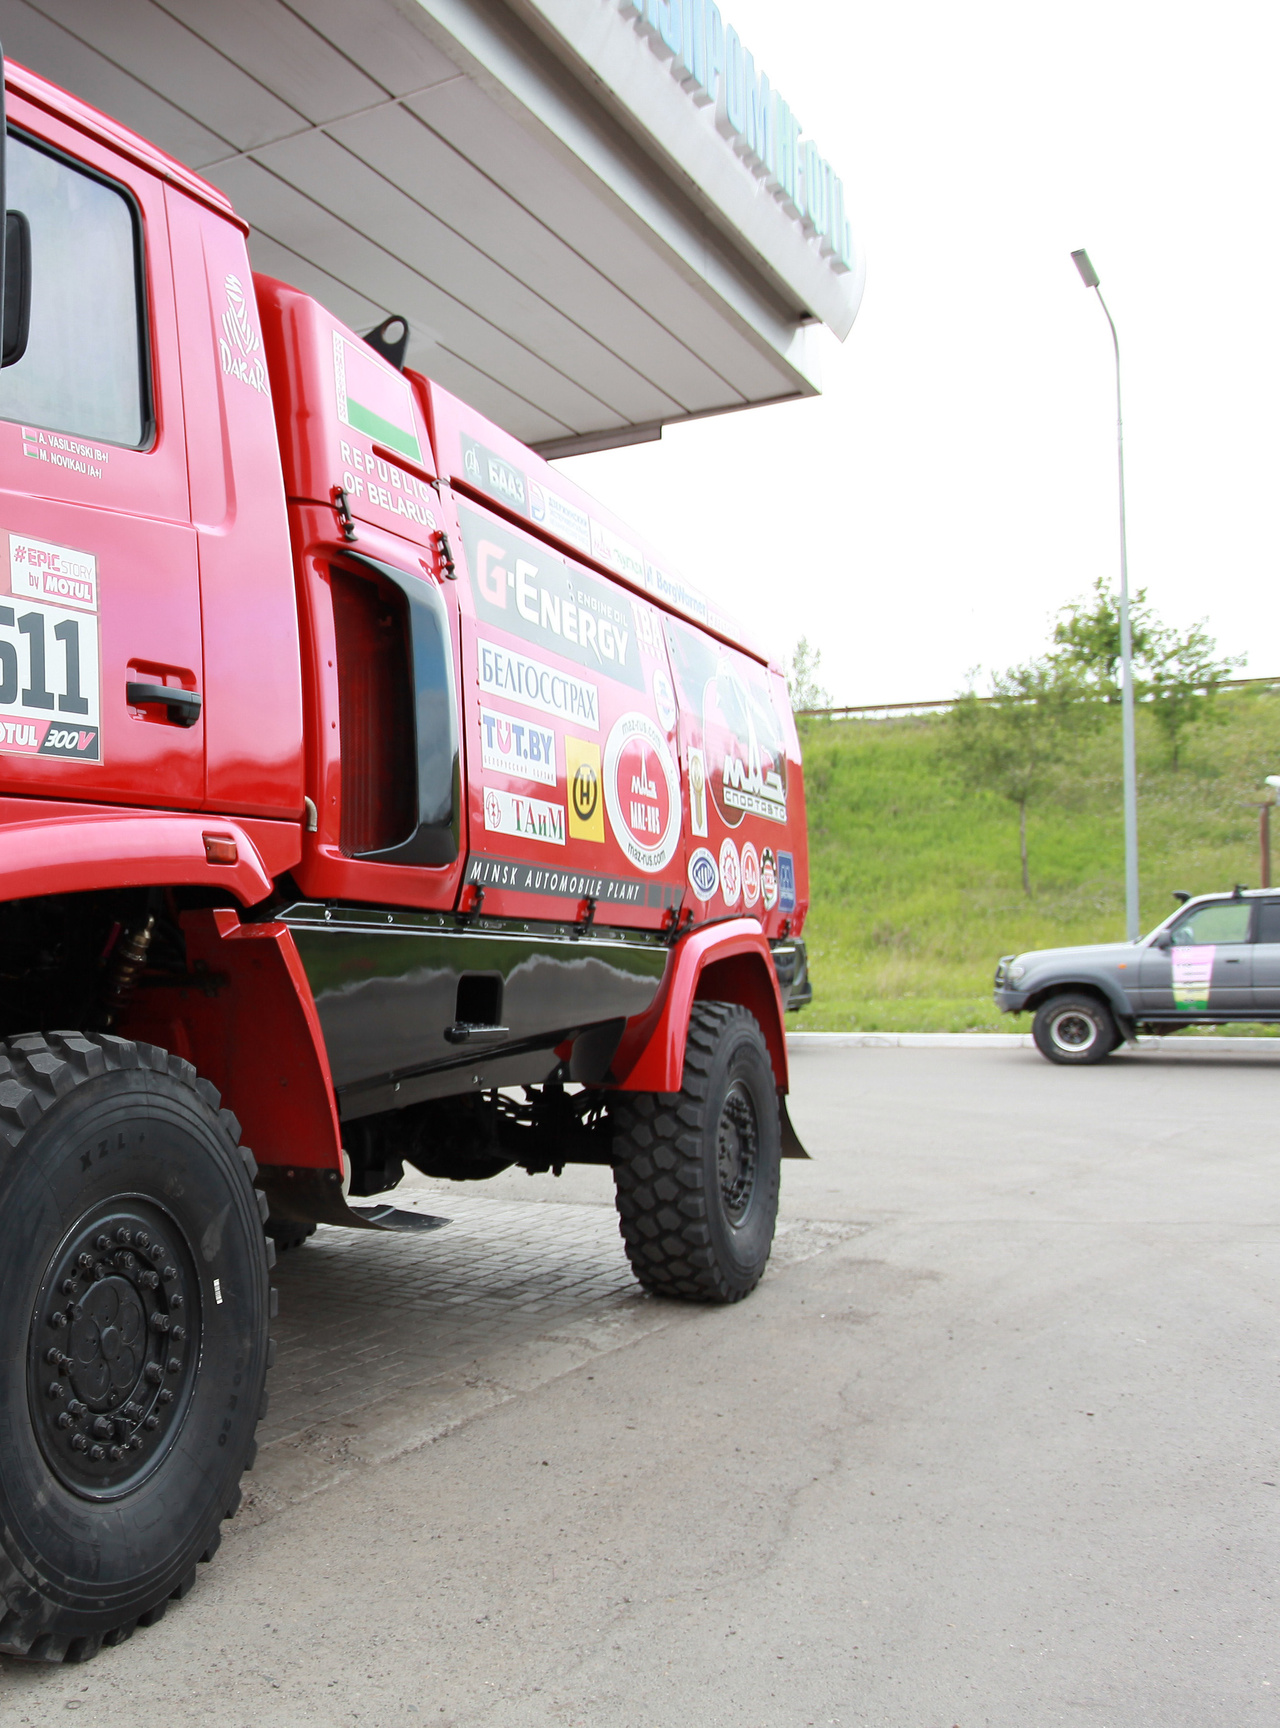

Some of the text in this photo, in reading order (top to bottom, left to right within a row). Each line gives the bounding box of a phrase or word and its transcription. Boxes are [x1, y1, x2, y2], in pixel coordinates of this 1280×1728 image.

[219, 337, 270, 397] DAKAR
[38, 432, 48, 445] A.
[48, 434, 93, 459] VASILEVSKI
[39, 448, 49, 462] M.
[50, 452, 86, 473] NOVIKAU
[339, 440, 431, 503] REPUBLIC
[488, 458, 525, 504] БААЗ
[343, 471, 437, 530] OF BELARUS
[28, 571, 92, 601] by MOTUL
[656, 570, 706, 617] BorgWarner
[577, 590, 628, 628] ENGINE OIL
[482, 647, 596, 722] БЕЛГОССТРАХ
[44, 729, 95, 751] 300V
[482, 714, 553, 766] TUT.BY
[622, 719, 662, 750] maz-rus.com
[630, 800, 661, 835] MAZ-RUS
[627, 842, 667, 868] maz-rus.com
[470, 860, 640, 901] MINSK AUTOMOBILE PLANT
